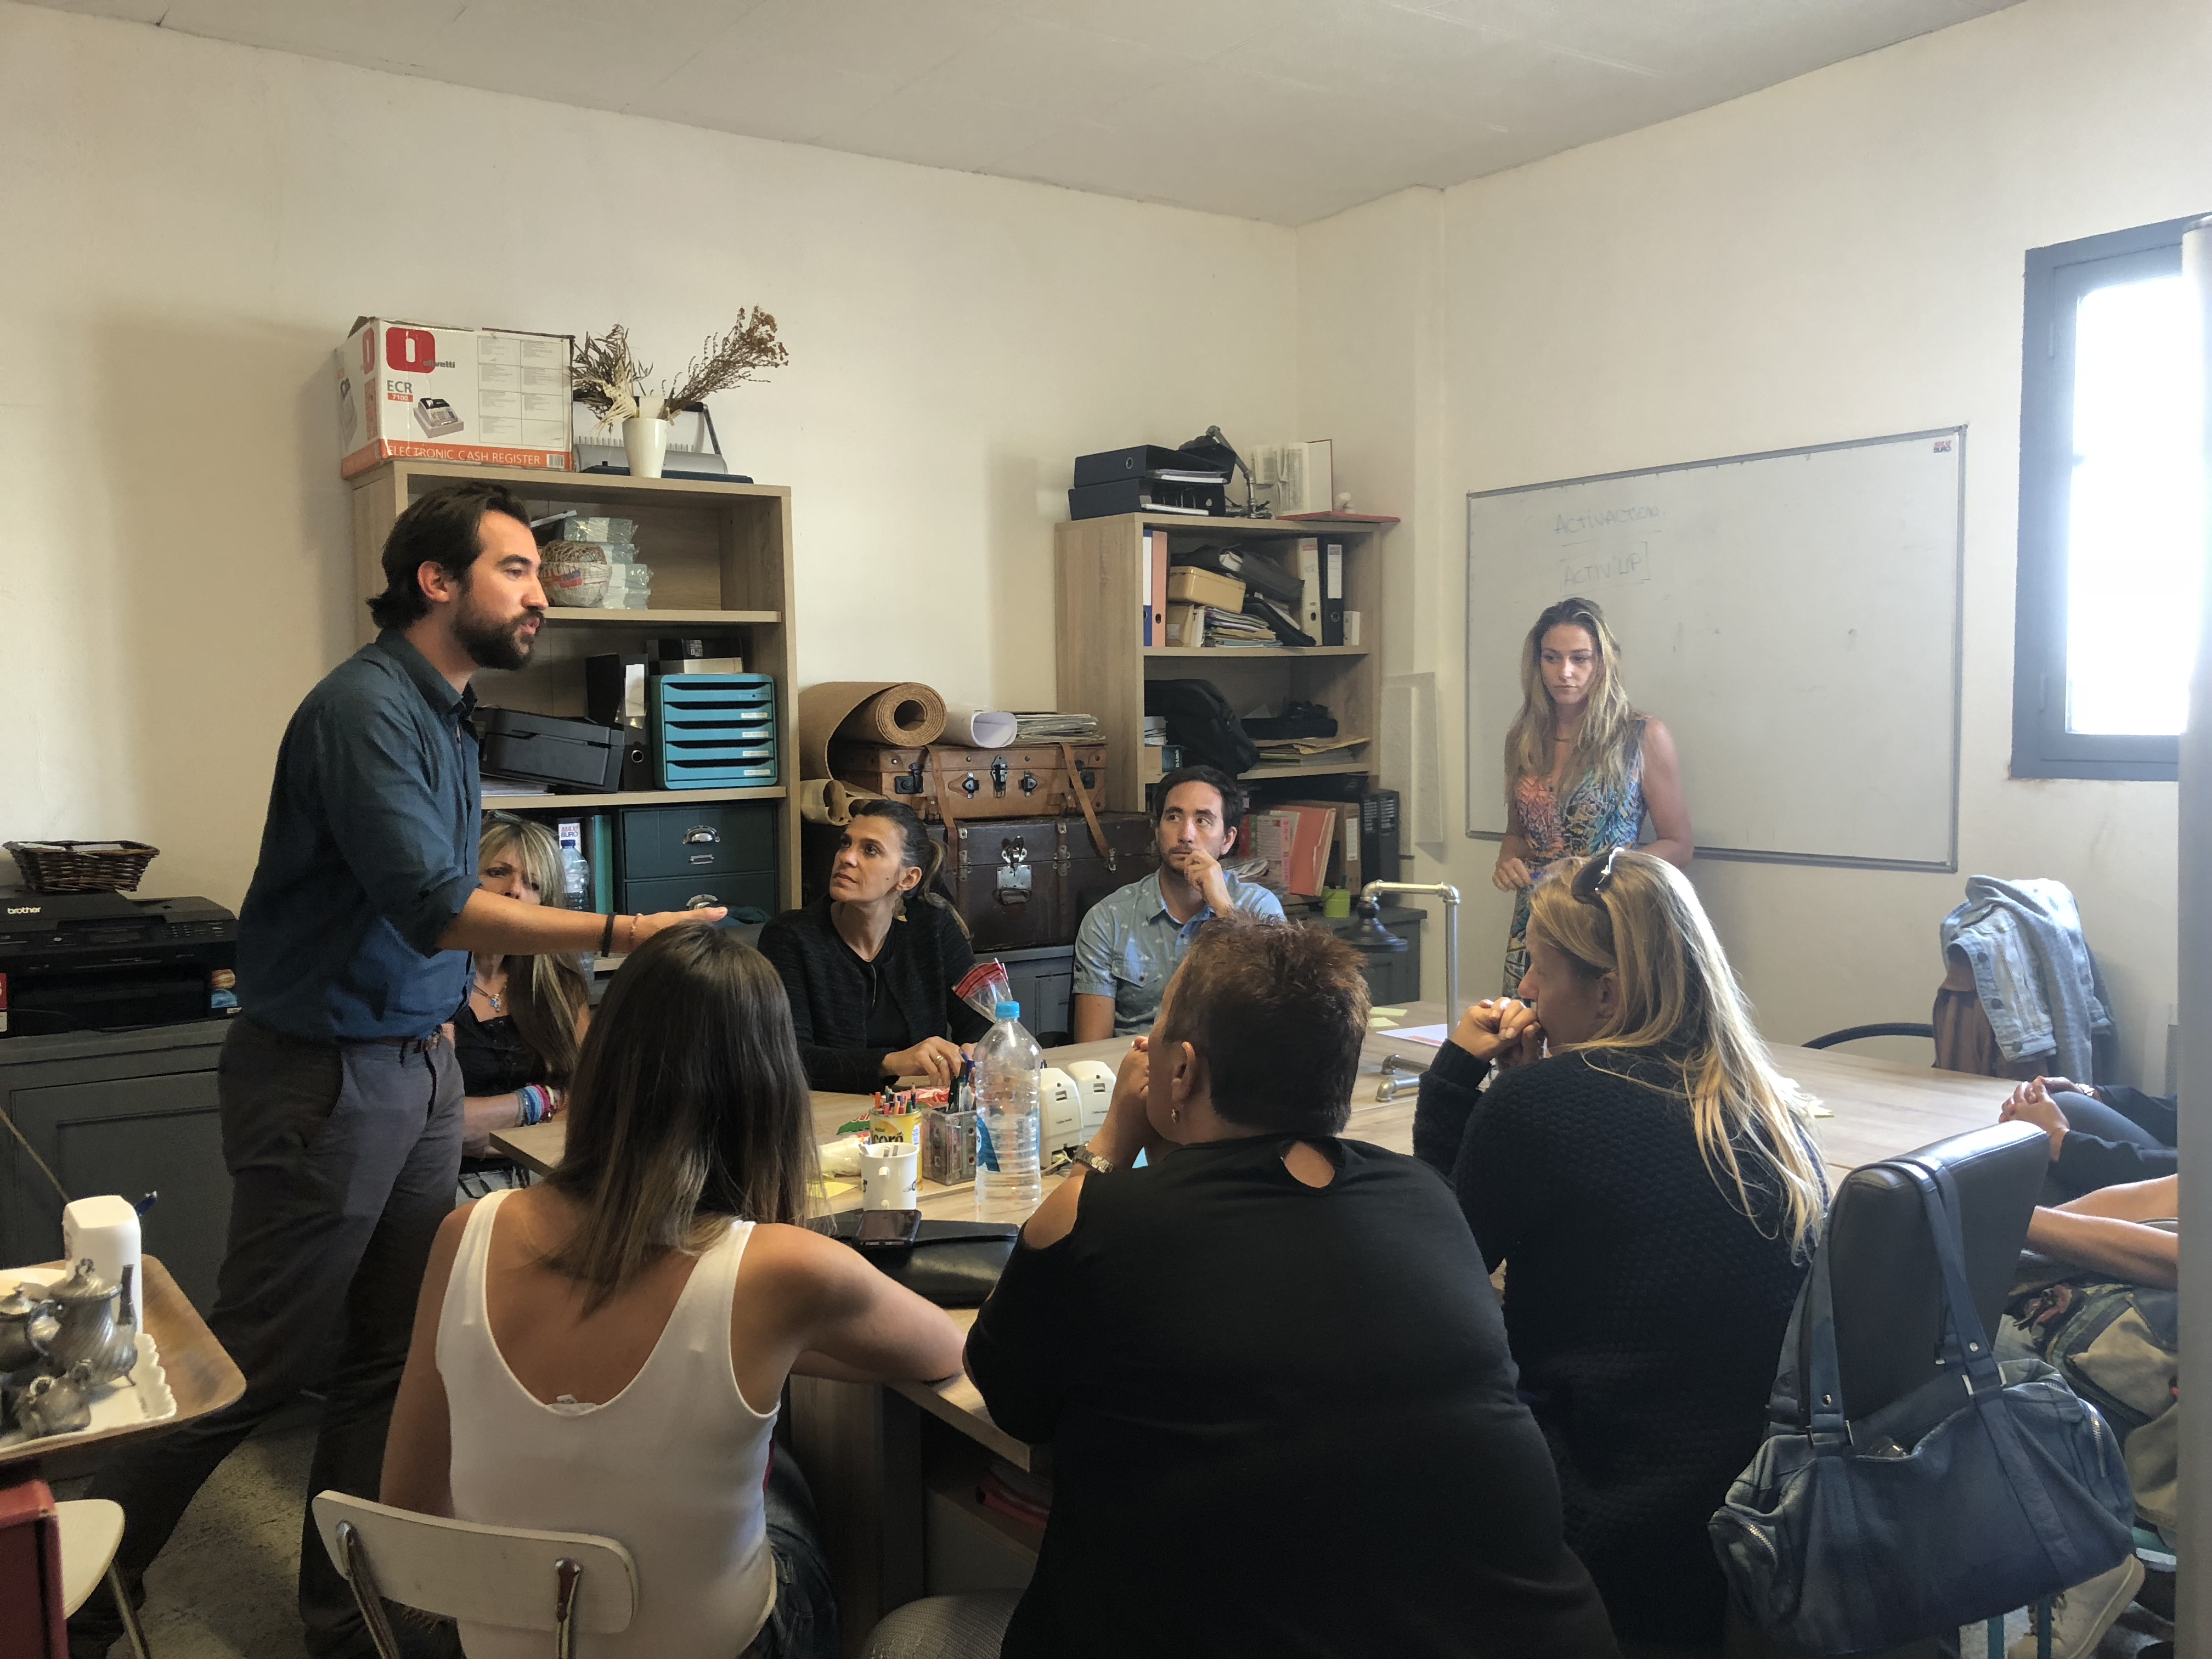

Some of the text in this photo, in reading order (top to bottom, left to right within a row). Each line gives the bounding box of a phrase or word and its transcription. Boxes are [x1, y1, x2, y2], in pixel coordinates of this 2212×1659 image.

[422, 359, 455, 368] olivetti
[387, 380, 413, 393] ECR
[388, 445, 540, 465] ELECTRONIC CASH REGISTER
